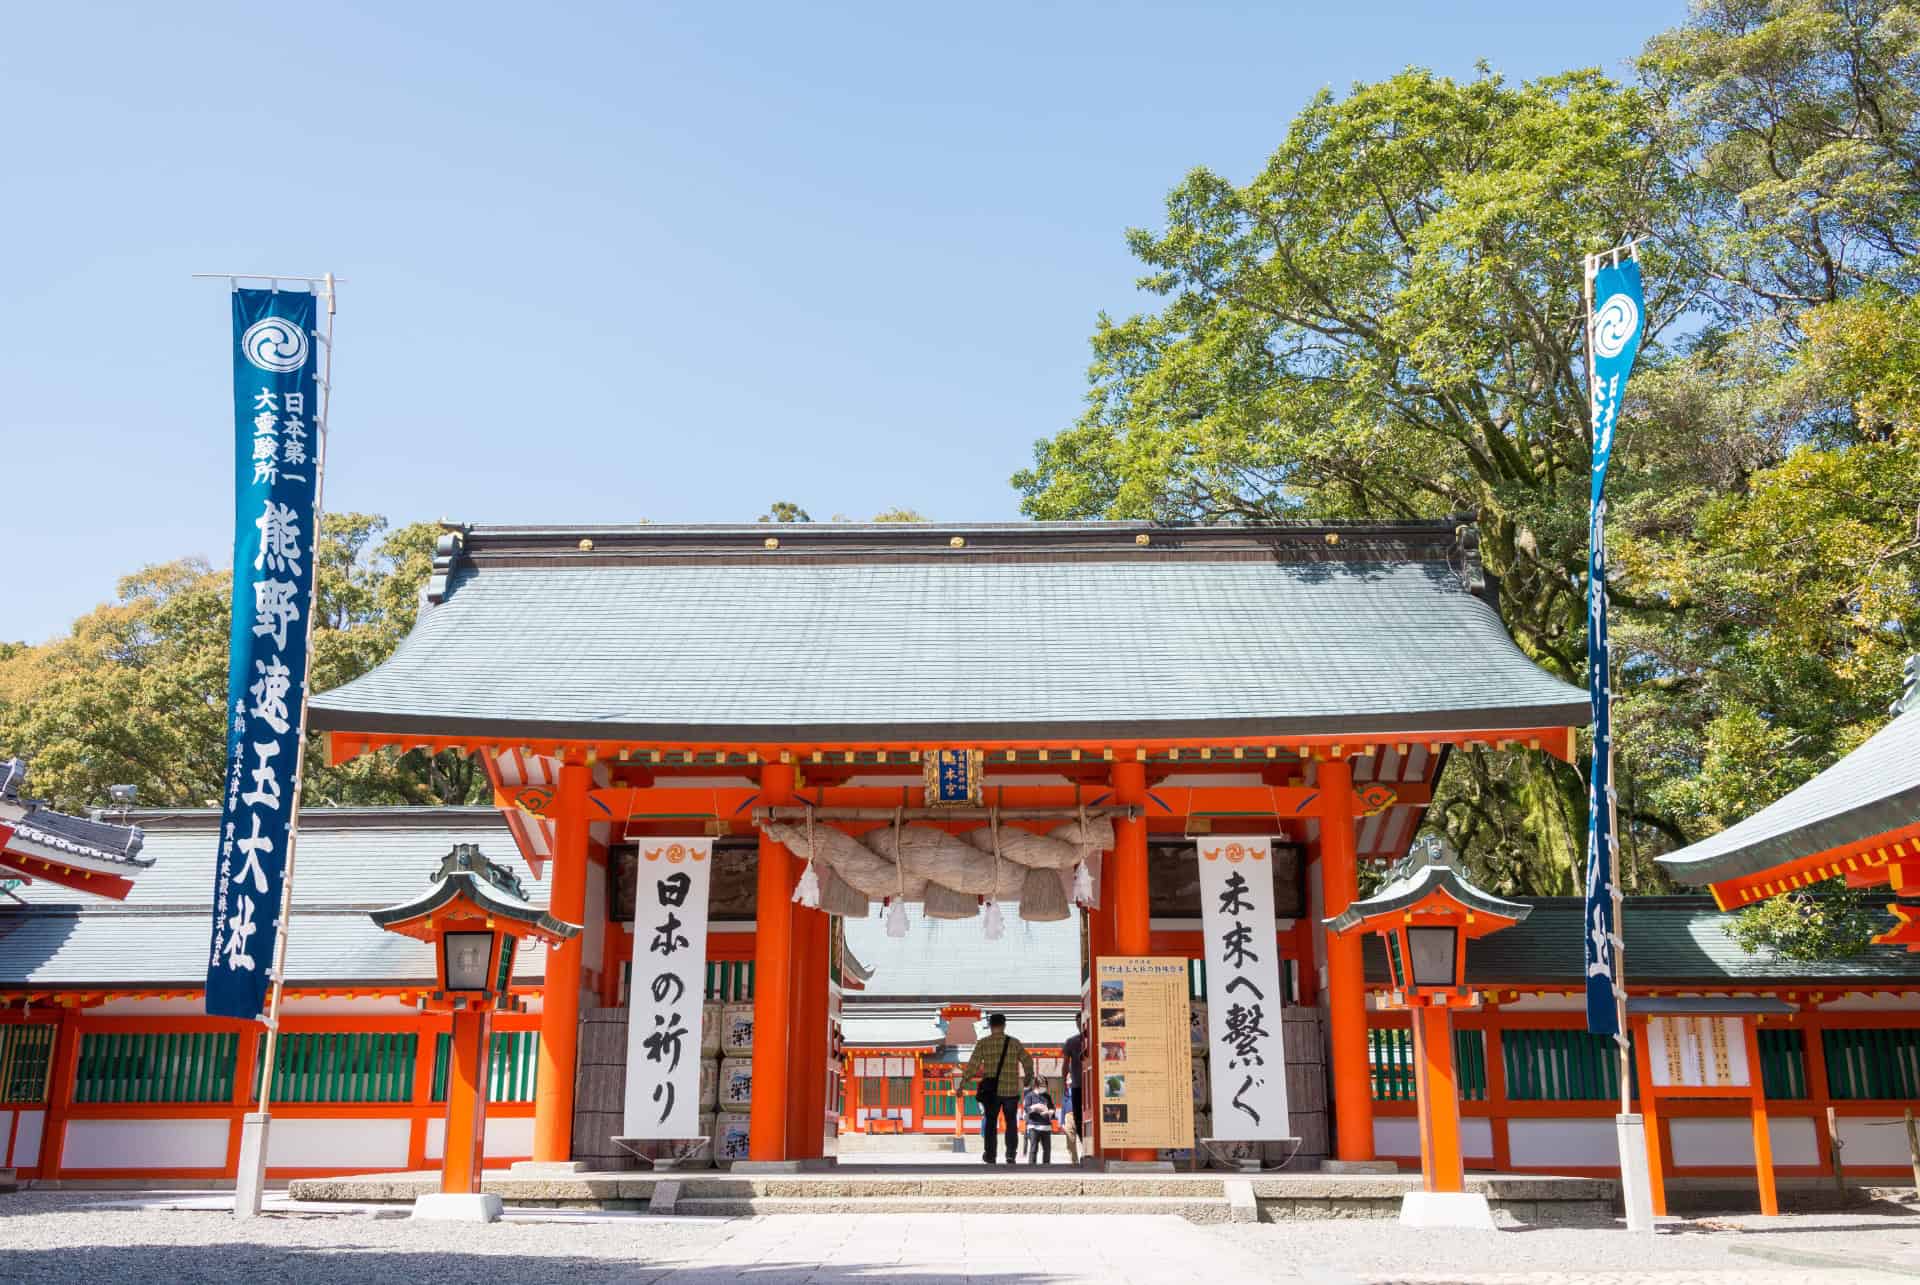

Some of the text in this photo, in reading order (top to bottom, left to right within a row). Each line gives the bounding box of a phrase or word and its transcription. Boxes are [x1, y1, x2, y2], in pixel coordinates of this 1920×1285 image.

[281, 392, 308, 483] 日本第一
[224, 500, 302, 971] 熊野速玉大社
[943, 752, 958, 797] 本宮
[643, 871, 692, 1124] 日本の祈り
